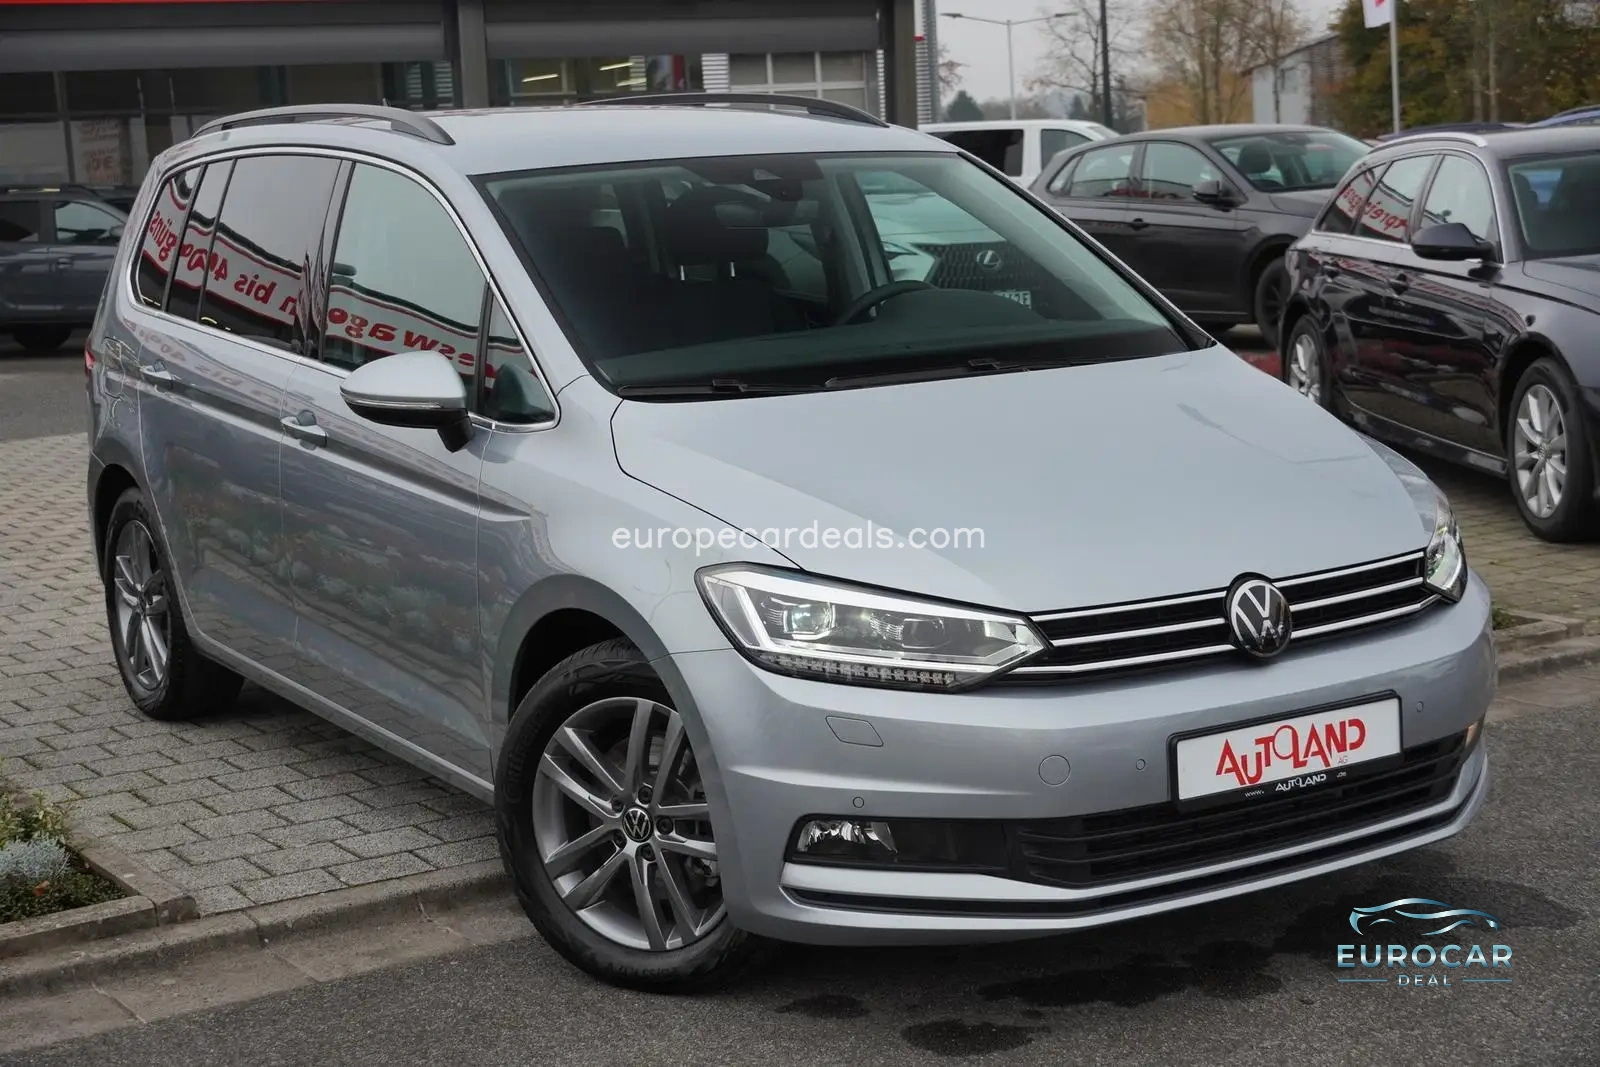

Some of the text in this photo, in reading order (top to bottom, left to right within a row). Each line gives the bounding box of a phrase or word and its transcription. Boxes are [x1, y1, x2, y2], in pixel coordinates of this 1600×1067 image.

[1216, 719, 1366, 785] AUTOLAND
[1338, 756, 1348, 764] AG
[1275, 774, 1327, 792] AUTOLAND
